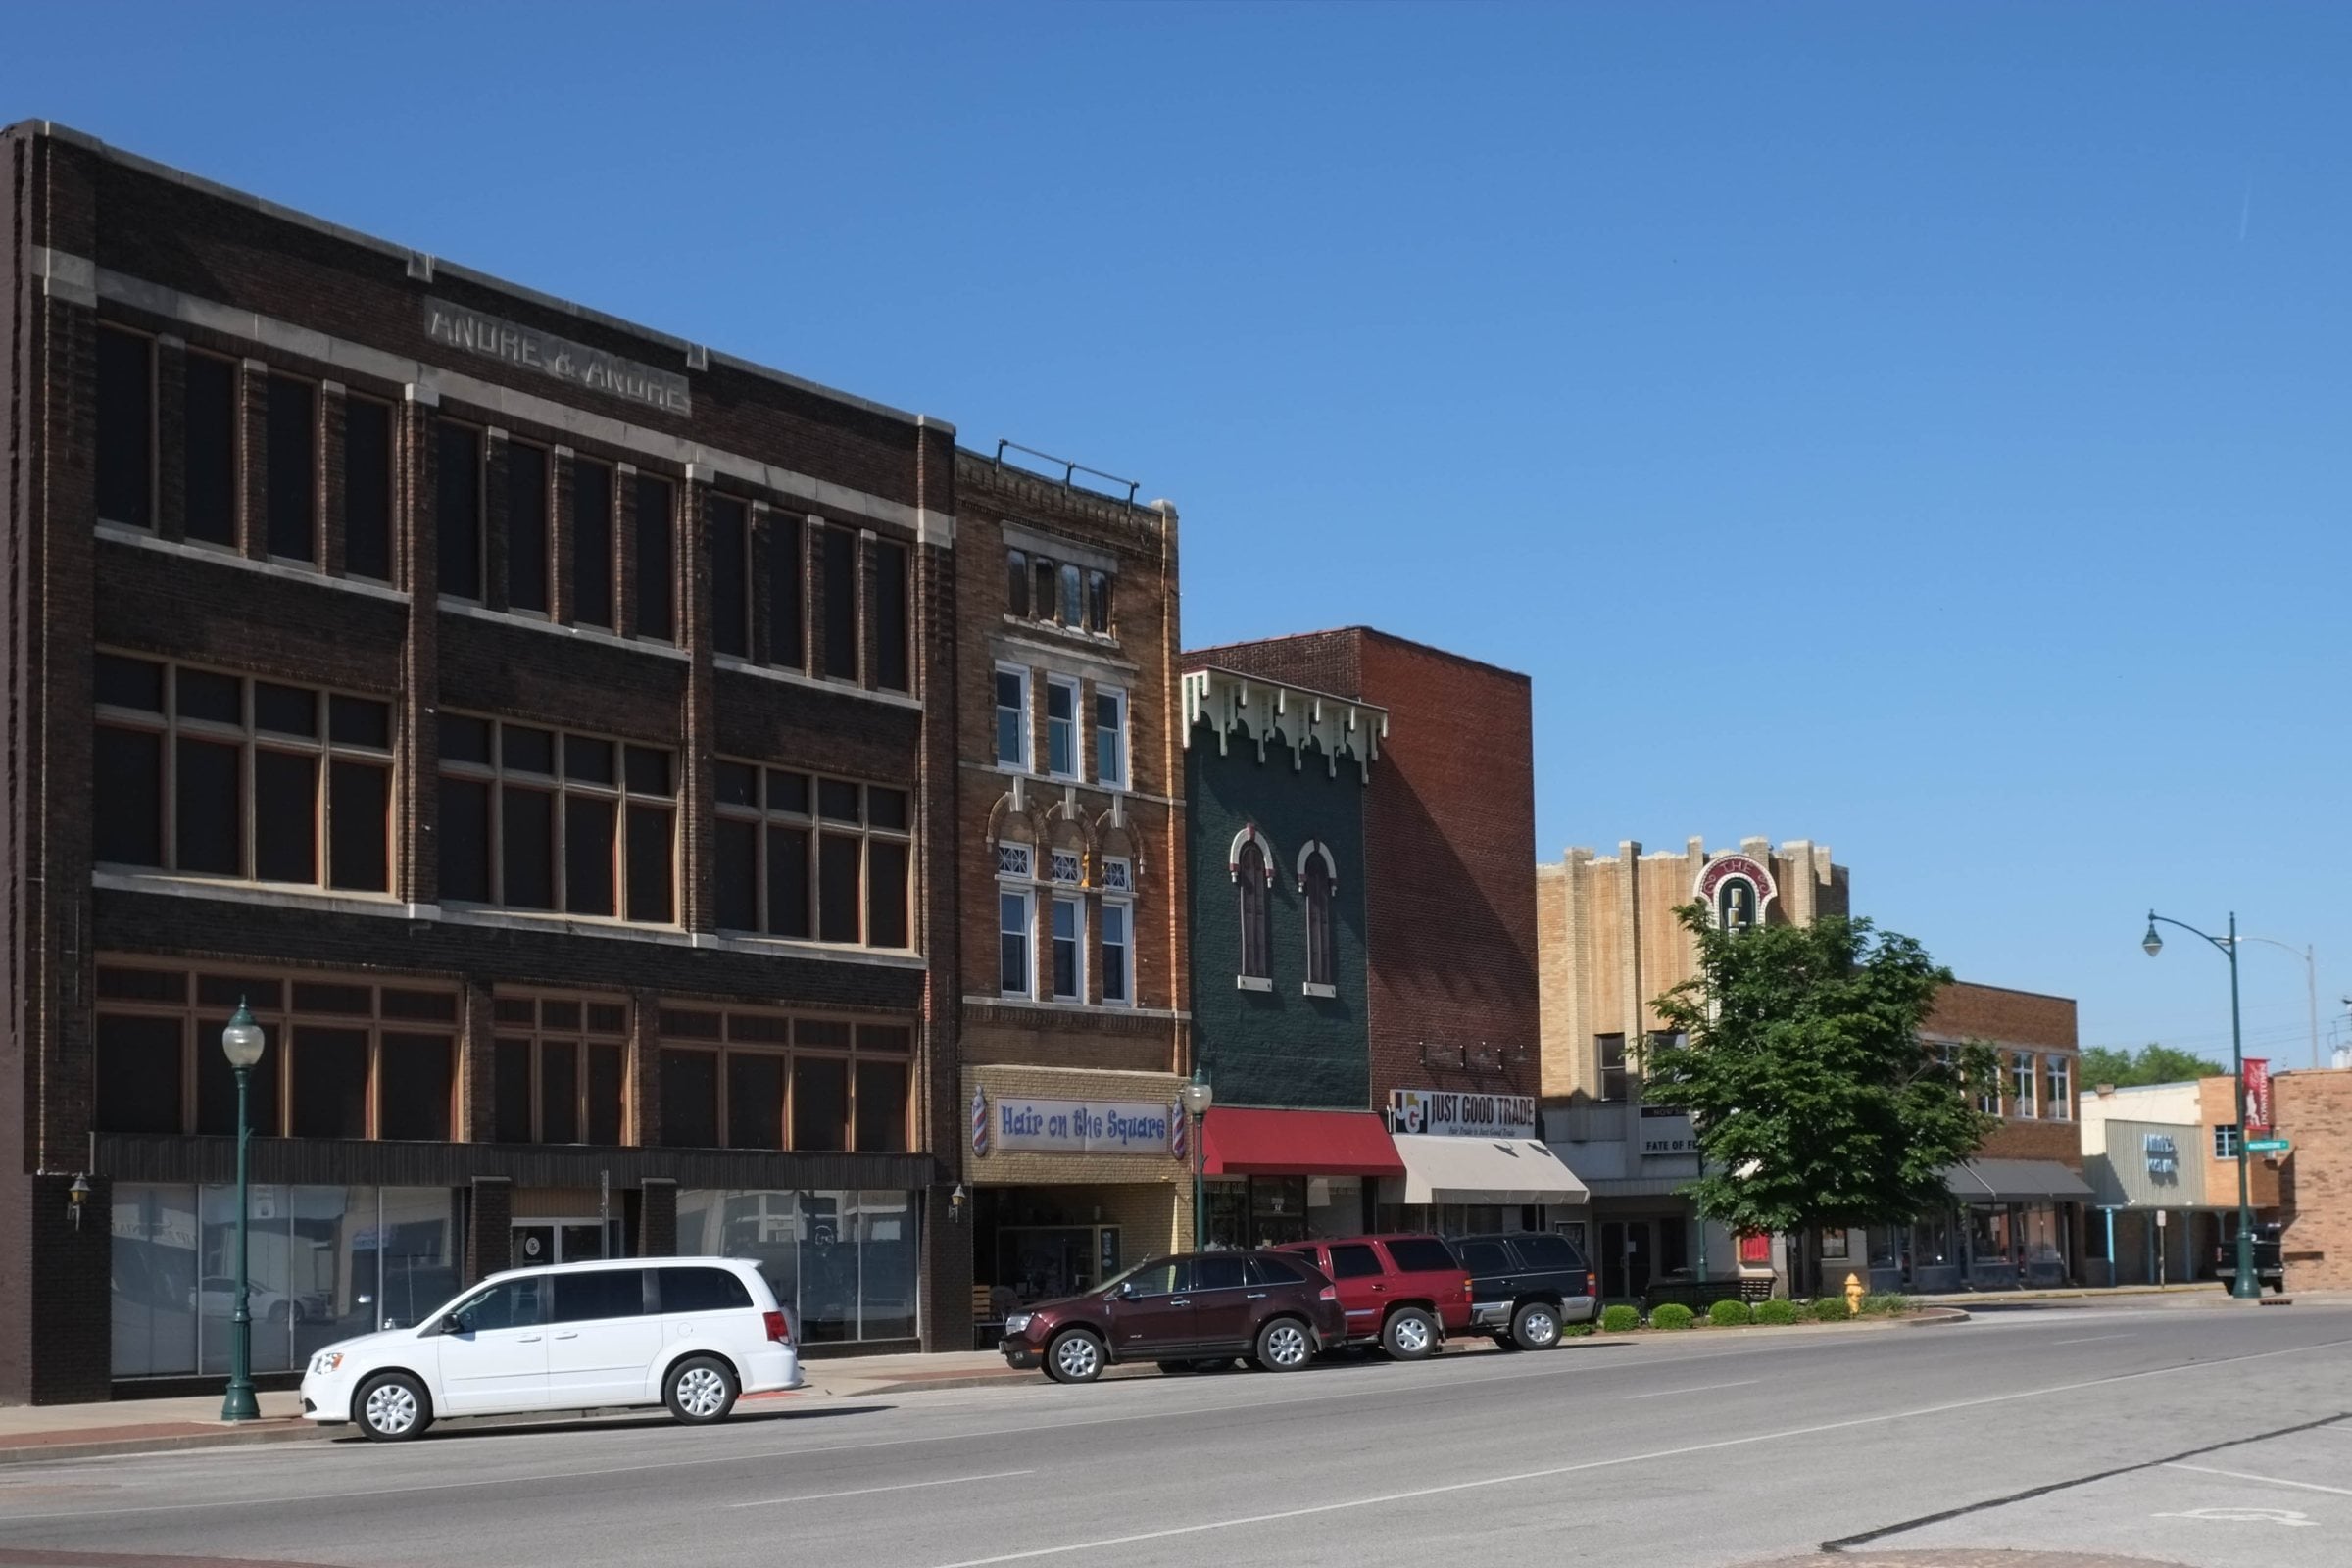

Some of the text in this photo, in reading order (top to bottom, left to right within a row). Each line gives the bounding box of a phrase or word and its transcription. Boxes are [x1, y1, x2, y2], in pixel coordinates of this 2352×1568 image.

[431, 312, 690, 416] ANDRE & ANDRE
[1720, 860, 1753, 874] THE
[1431, 1094, 1534, 1126] JUST GOOD TRADE
[2260, 1063, 2269, 1126] DOWNTOWN
[1001, 1105, 1165, 1145] Hair on the Square
[1646, 1141, 1669, 1151] FATE
[1672, 1140, 1684, 1150] OF
